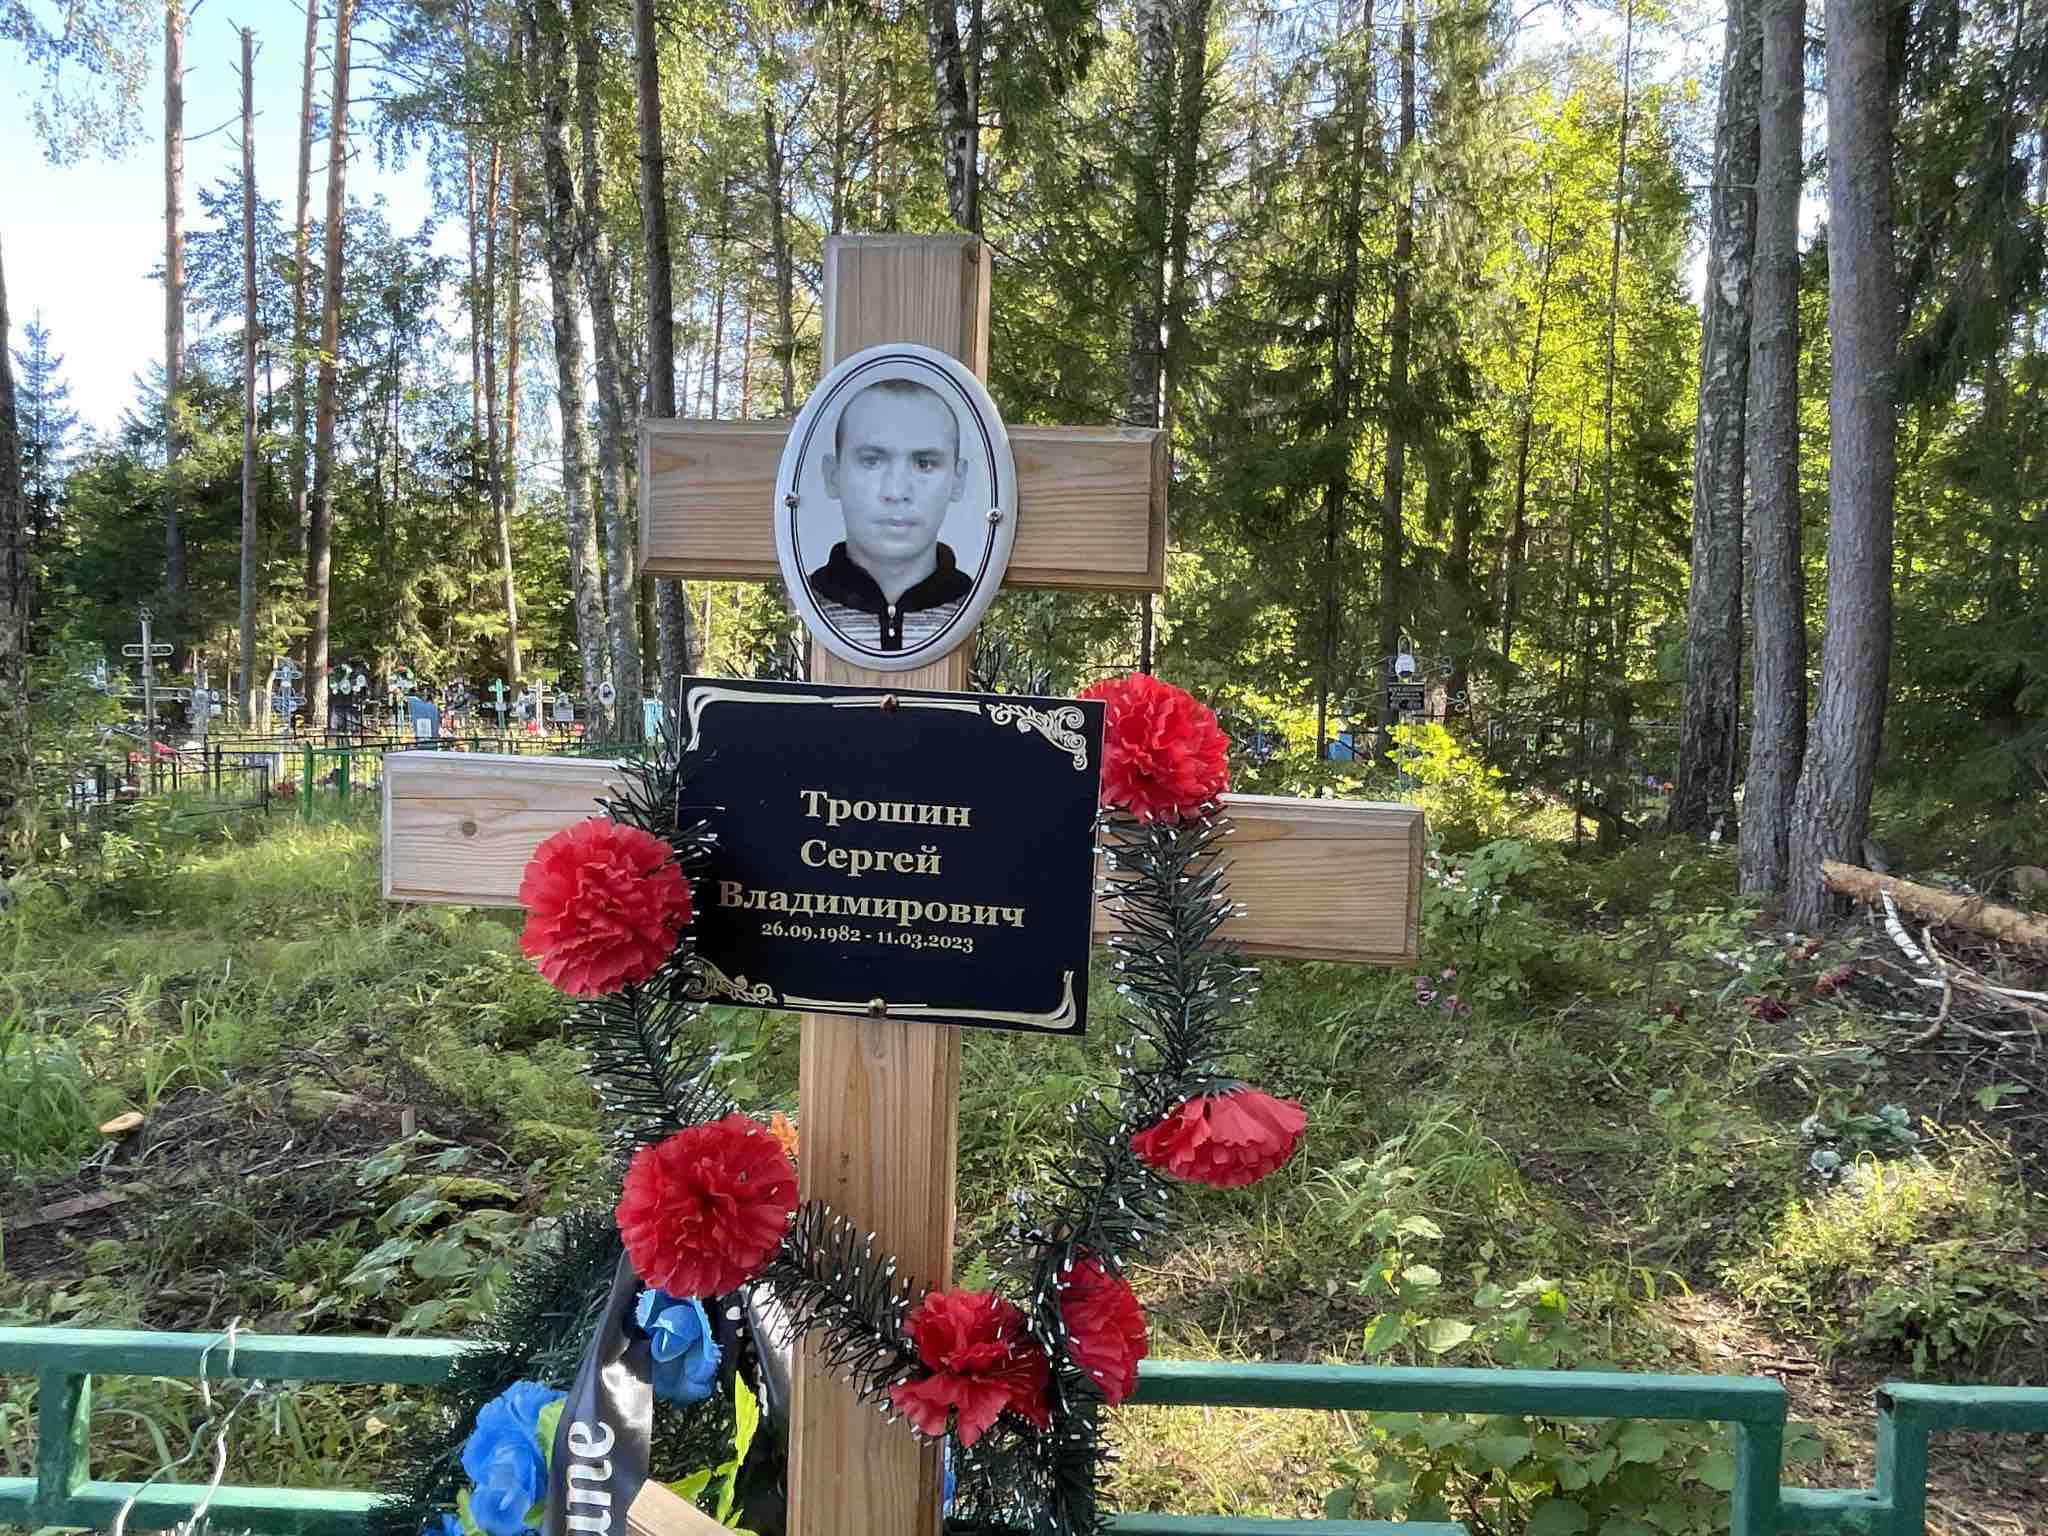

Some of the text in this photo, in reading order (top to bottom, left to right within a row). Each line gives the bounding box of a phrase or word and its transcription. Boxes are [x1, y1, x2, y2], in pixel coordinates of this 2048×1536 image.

[800, 790, 972, 827] Трошин
[800, 839, 943, 877] Сергей
[717, 880, 1025, 928] Владимирович
[761, 921, 862, 943] 26.09.1982
[877, 931, 974, 954] 11.03.2023
